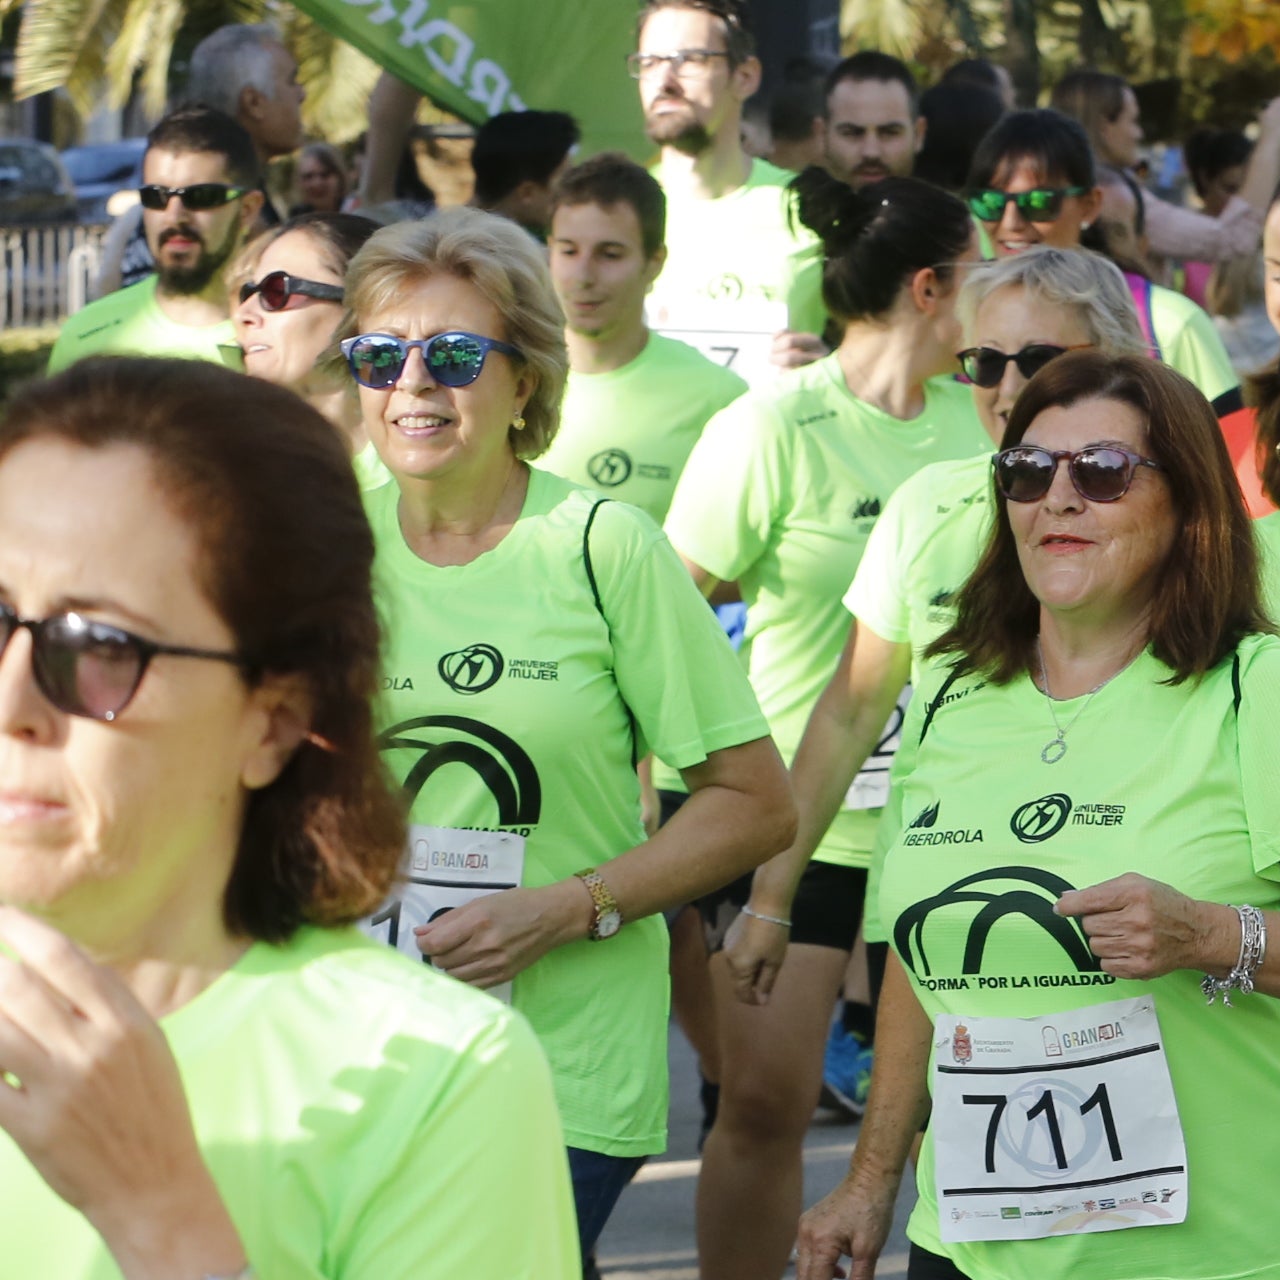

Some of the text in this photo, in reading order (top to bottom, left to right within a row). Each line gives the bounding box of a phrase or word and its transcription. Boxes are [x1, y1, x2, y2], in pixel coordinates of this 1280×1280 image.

[508, 659, 559, 670] UNIVERSO
[507, 669, 559, 681] MUJER
[1073, 804, 1126, 814] UNIVERSO
[1072, 813, 1124, 826] MUJER
[903, 829, 984, 846] IBERDROLA
[431, 851, 489, 869] GRANADA
[978, 977, 1008, 989] POR
[1011, 976, 1031, 988] LA
[1034, 974, 1117, 987] IGUALDAD
[1063, 1022, 1124, 1049] GRANADA
[962, 1082, 1123, 1173] 711
